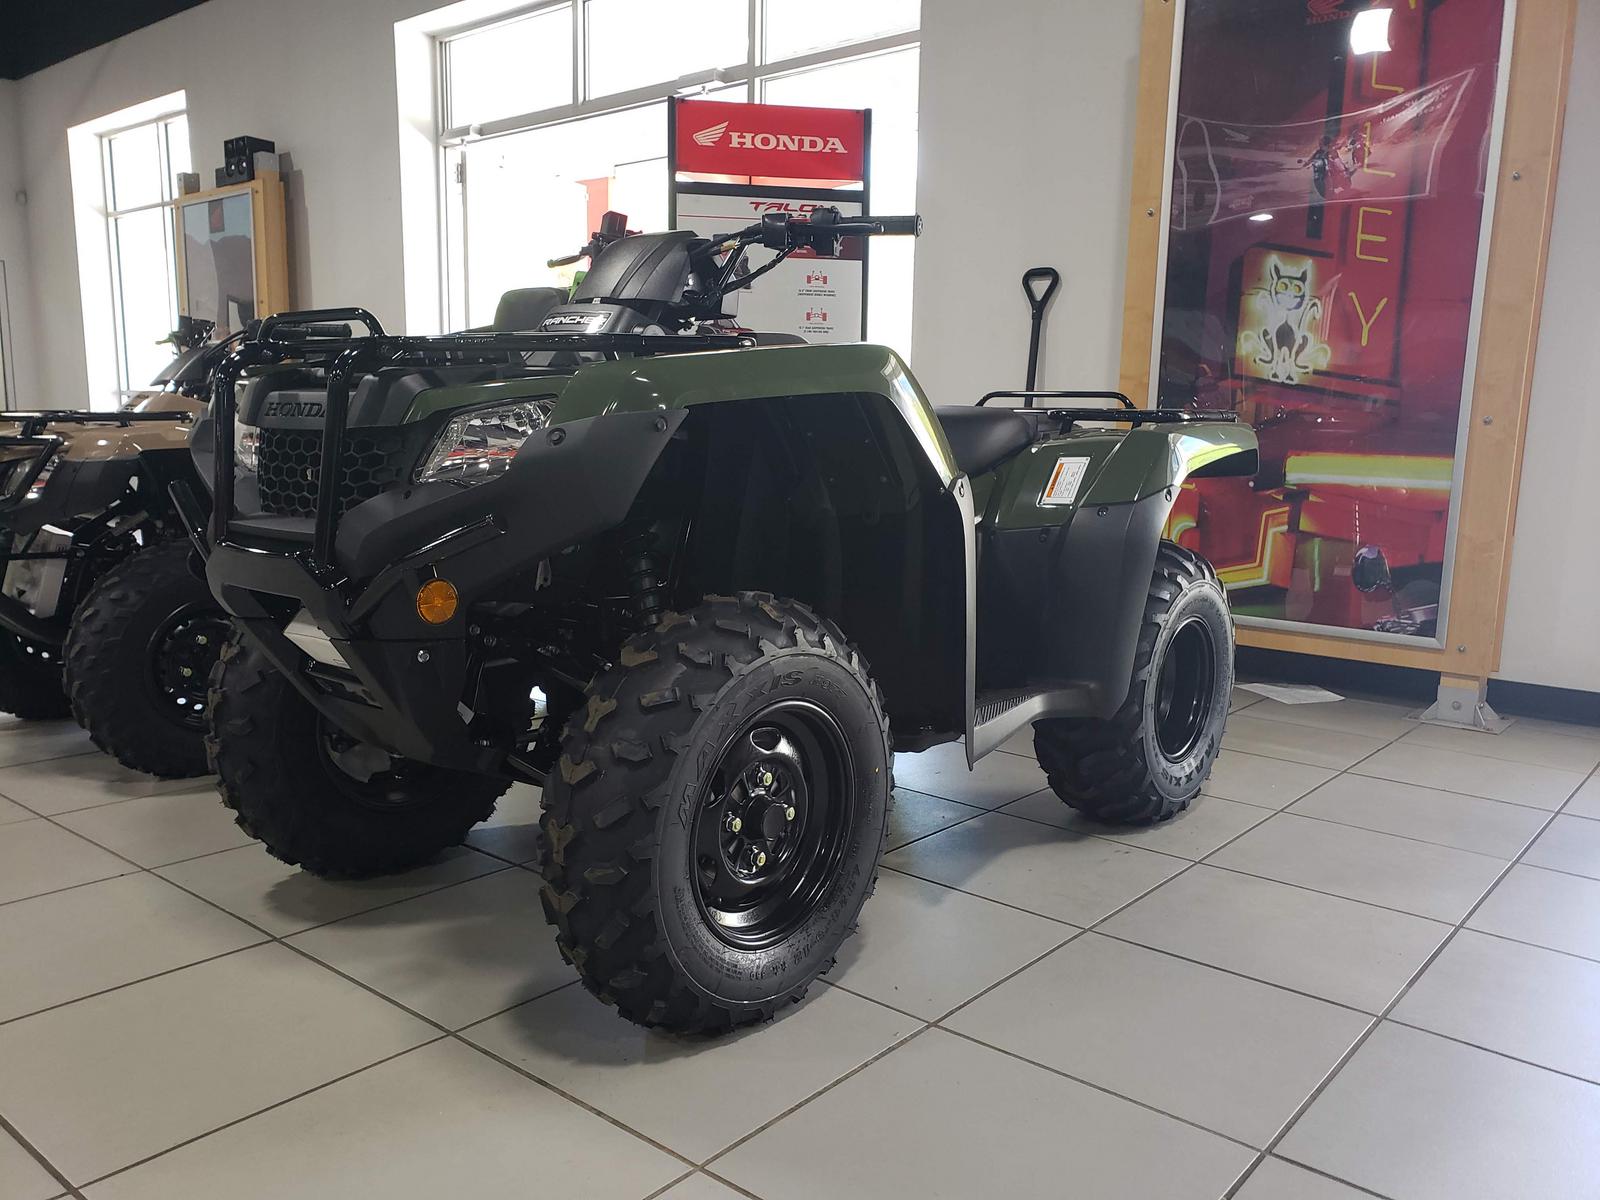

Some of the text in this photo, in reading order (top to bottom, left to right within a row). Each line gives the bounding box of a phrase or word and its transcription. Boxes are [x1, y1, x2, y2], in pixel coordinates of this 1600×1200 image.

[1306, 11, 1357, 25] HOND
[728, 131, 848, 153] HONDA
[750, 202, 824, 213] TALO
